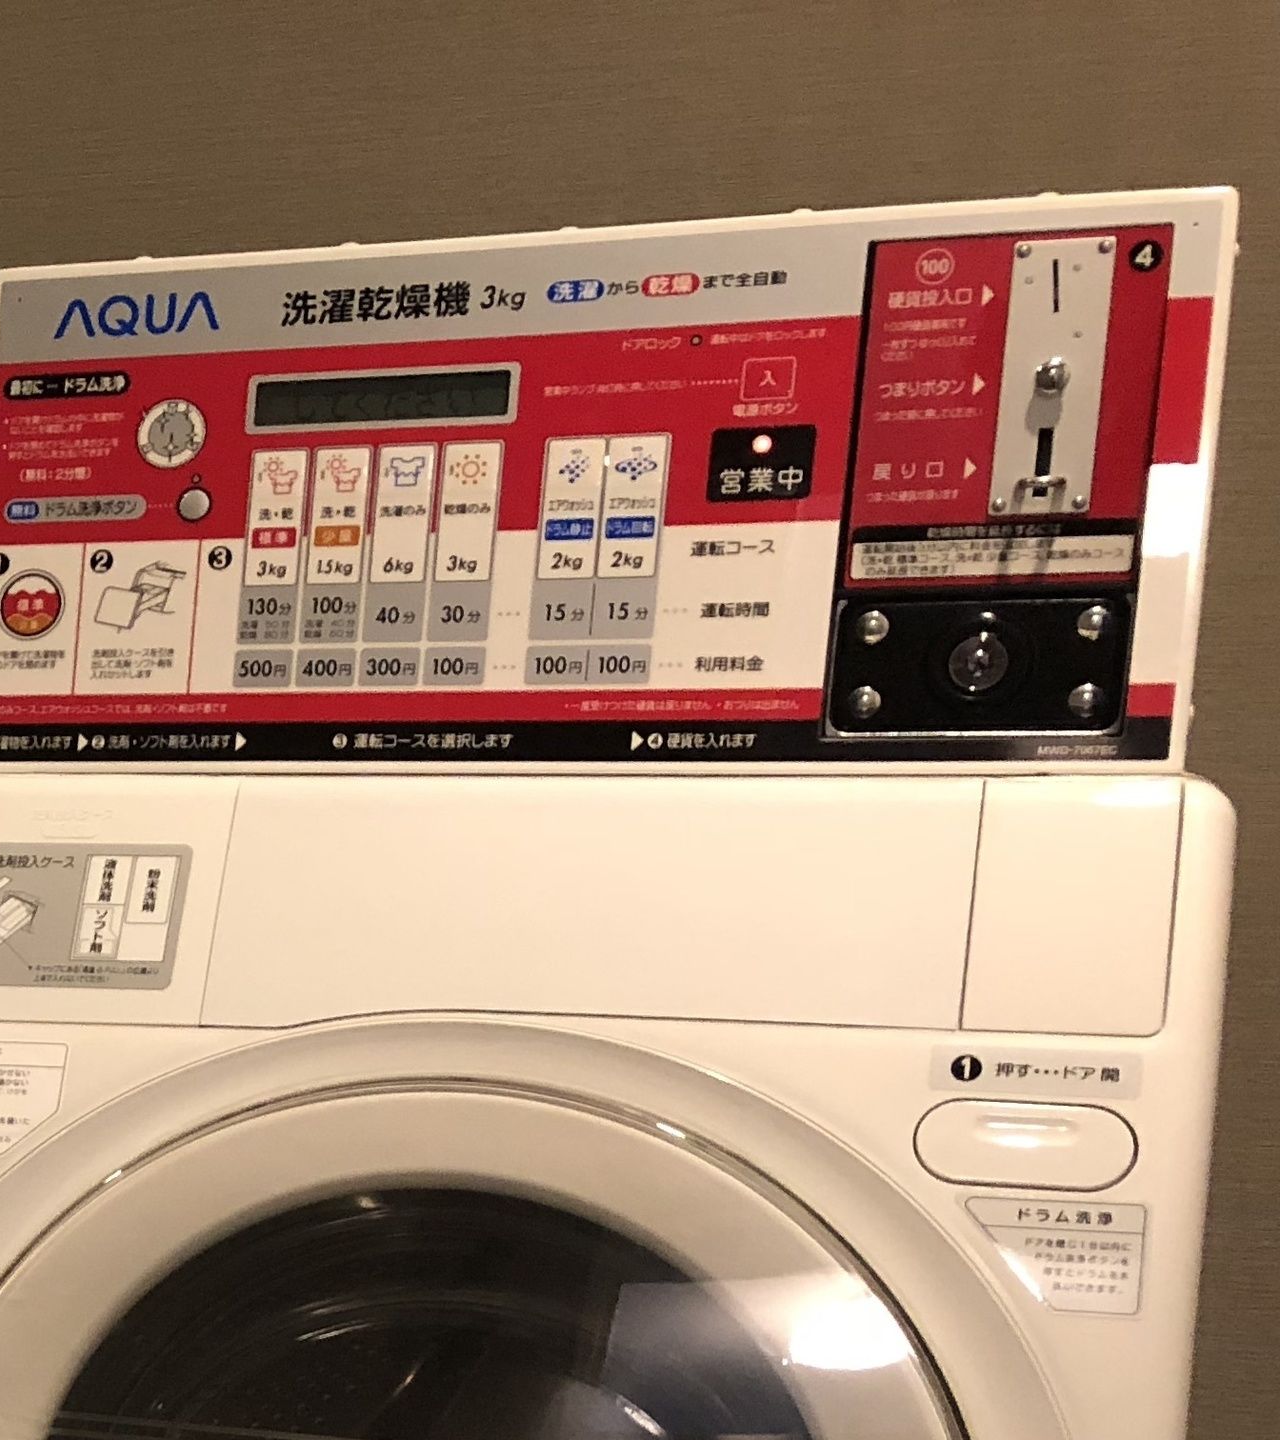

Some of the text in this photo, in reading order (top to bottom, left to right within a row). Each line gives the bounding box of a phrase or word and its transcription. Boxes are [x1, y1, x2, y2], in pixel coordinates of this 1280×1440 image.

[921, 259, 949, 274] 100
[54, 270, 788, 339] AQUA 洗濯乾燥機 3kg 洗濯 から 乾燥 まで全自動
[758, 370, 776, 387] 入
[879, 378, 967, 398] つまりボタン
[720, 466, 803, 494] 営業中
[256, 560, 287, 578] 3kg
[383, 557, 414, 575] 6kg
[446, 555, 478, 574] 3kg
[551, 552, 584, 570] 2kg
[611, 551, 644, 569] 2kg
[690, 539, 776, 557] 運転コース
[247, 596, 770, 625] 130分 100分 40分 30分 15分 15分 運転時間
[238, 655, 764, 678] 500円 400円 300円 100円 100円 100円 利用料金
[1017, 1207, 1113, 1226] ドラム洗浄
